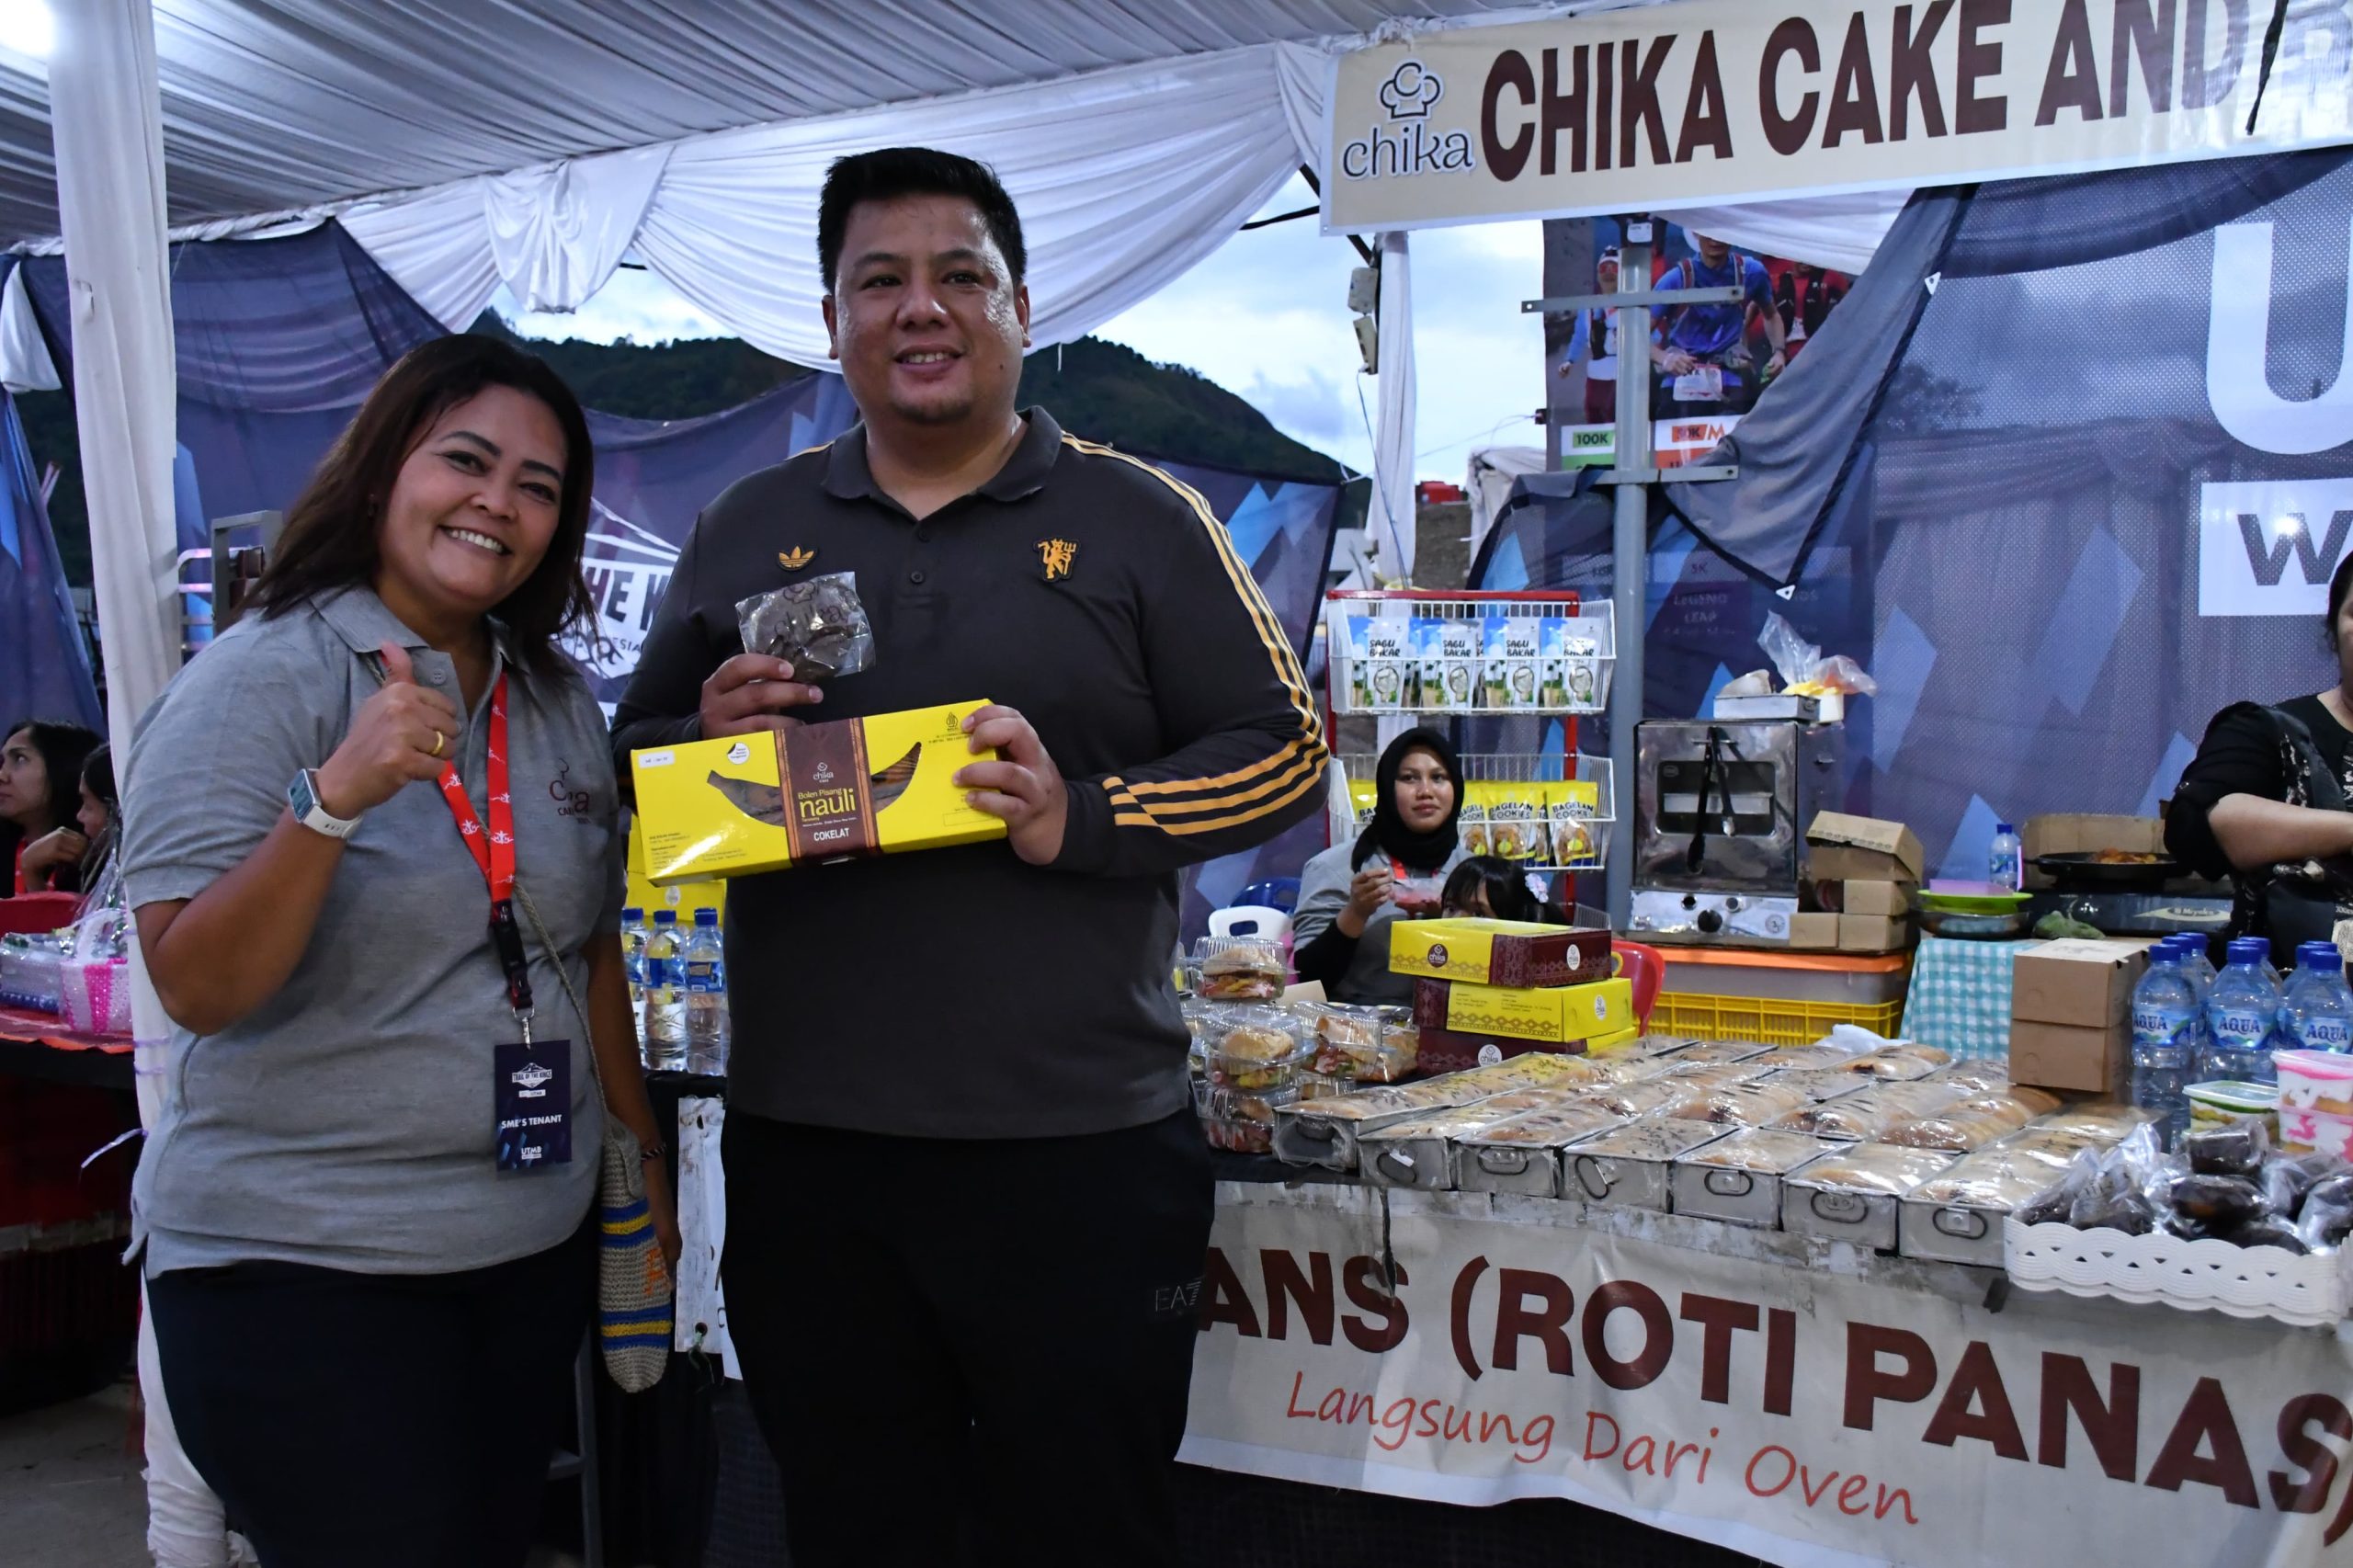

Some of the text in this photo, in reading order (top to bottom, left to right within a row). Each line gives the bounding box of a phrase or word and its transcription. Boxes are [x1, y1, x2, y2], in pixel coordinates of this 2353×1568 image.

[1481, 29, 1733, 182] CHIKA
[1759, 0, 2012, 156] CAKE
[2033, 0, 2250, 127] AND
[1342, 125, 1473, 176] chika
[1576, 433, 1608, 445] 100K
[585, 567, 635, 623] HE
[1370, 639, 1395, 648] SAGU
[1443, 639, 1466, 648] SAGU
[1506, 639, 1529, 648] SAGU
[1370, 648, 1401, 657] BKAR
[1444, 648, 1472, 657] BAKAR
[1506, 648, 1536, 657] BAKAR
[798, 788, 843, 800] Bolen Pisang
[799, 788, 857, 818] nauli
[1490, 801, 1533, 812] BAGELAN
[1552, 801, 1594, 812] BAGELAN
[813, 827, 850, 842] COKELAT
[2132, 1014, 2168, 1031] AQUA
[2218, 1016, 2261, 1034] AQUA
[2305, 1024, 2348, 1041] AQUA
[501, 1114, 563, 1130] SME'S TENANT
[521, 1146, 541, 1154] UTMB
[1450, 1256, 1797, 1417] (ROTI
[1843, 1321, 2353, 1548] PANAS)
[1287, 1371, 1919, 1525] Langsung Dari Oven
